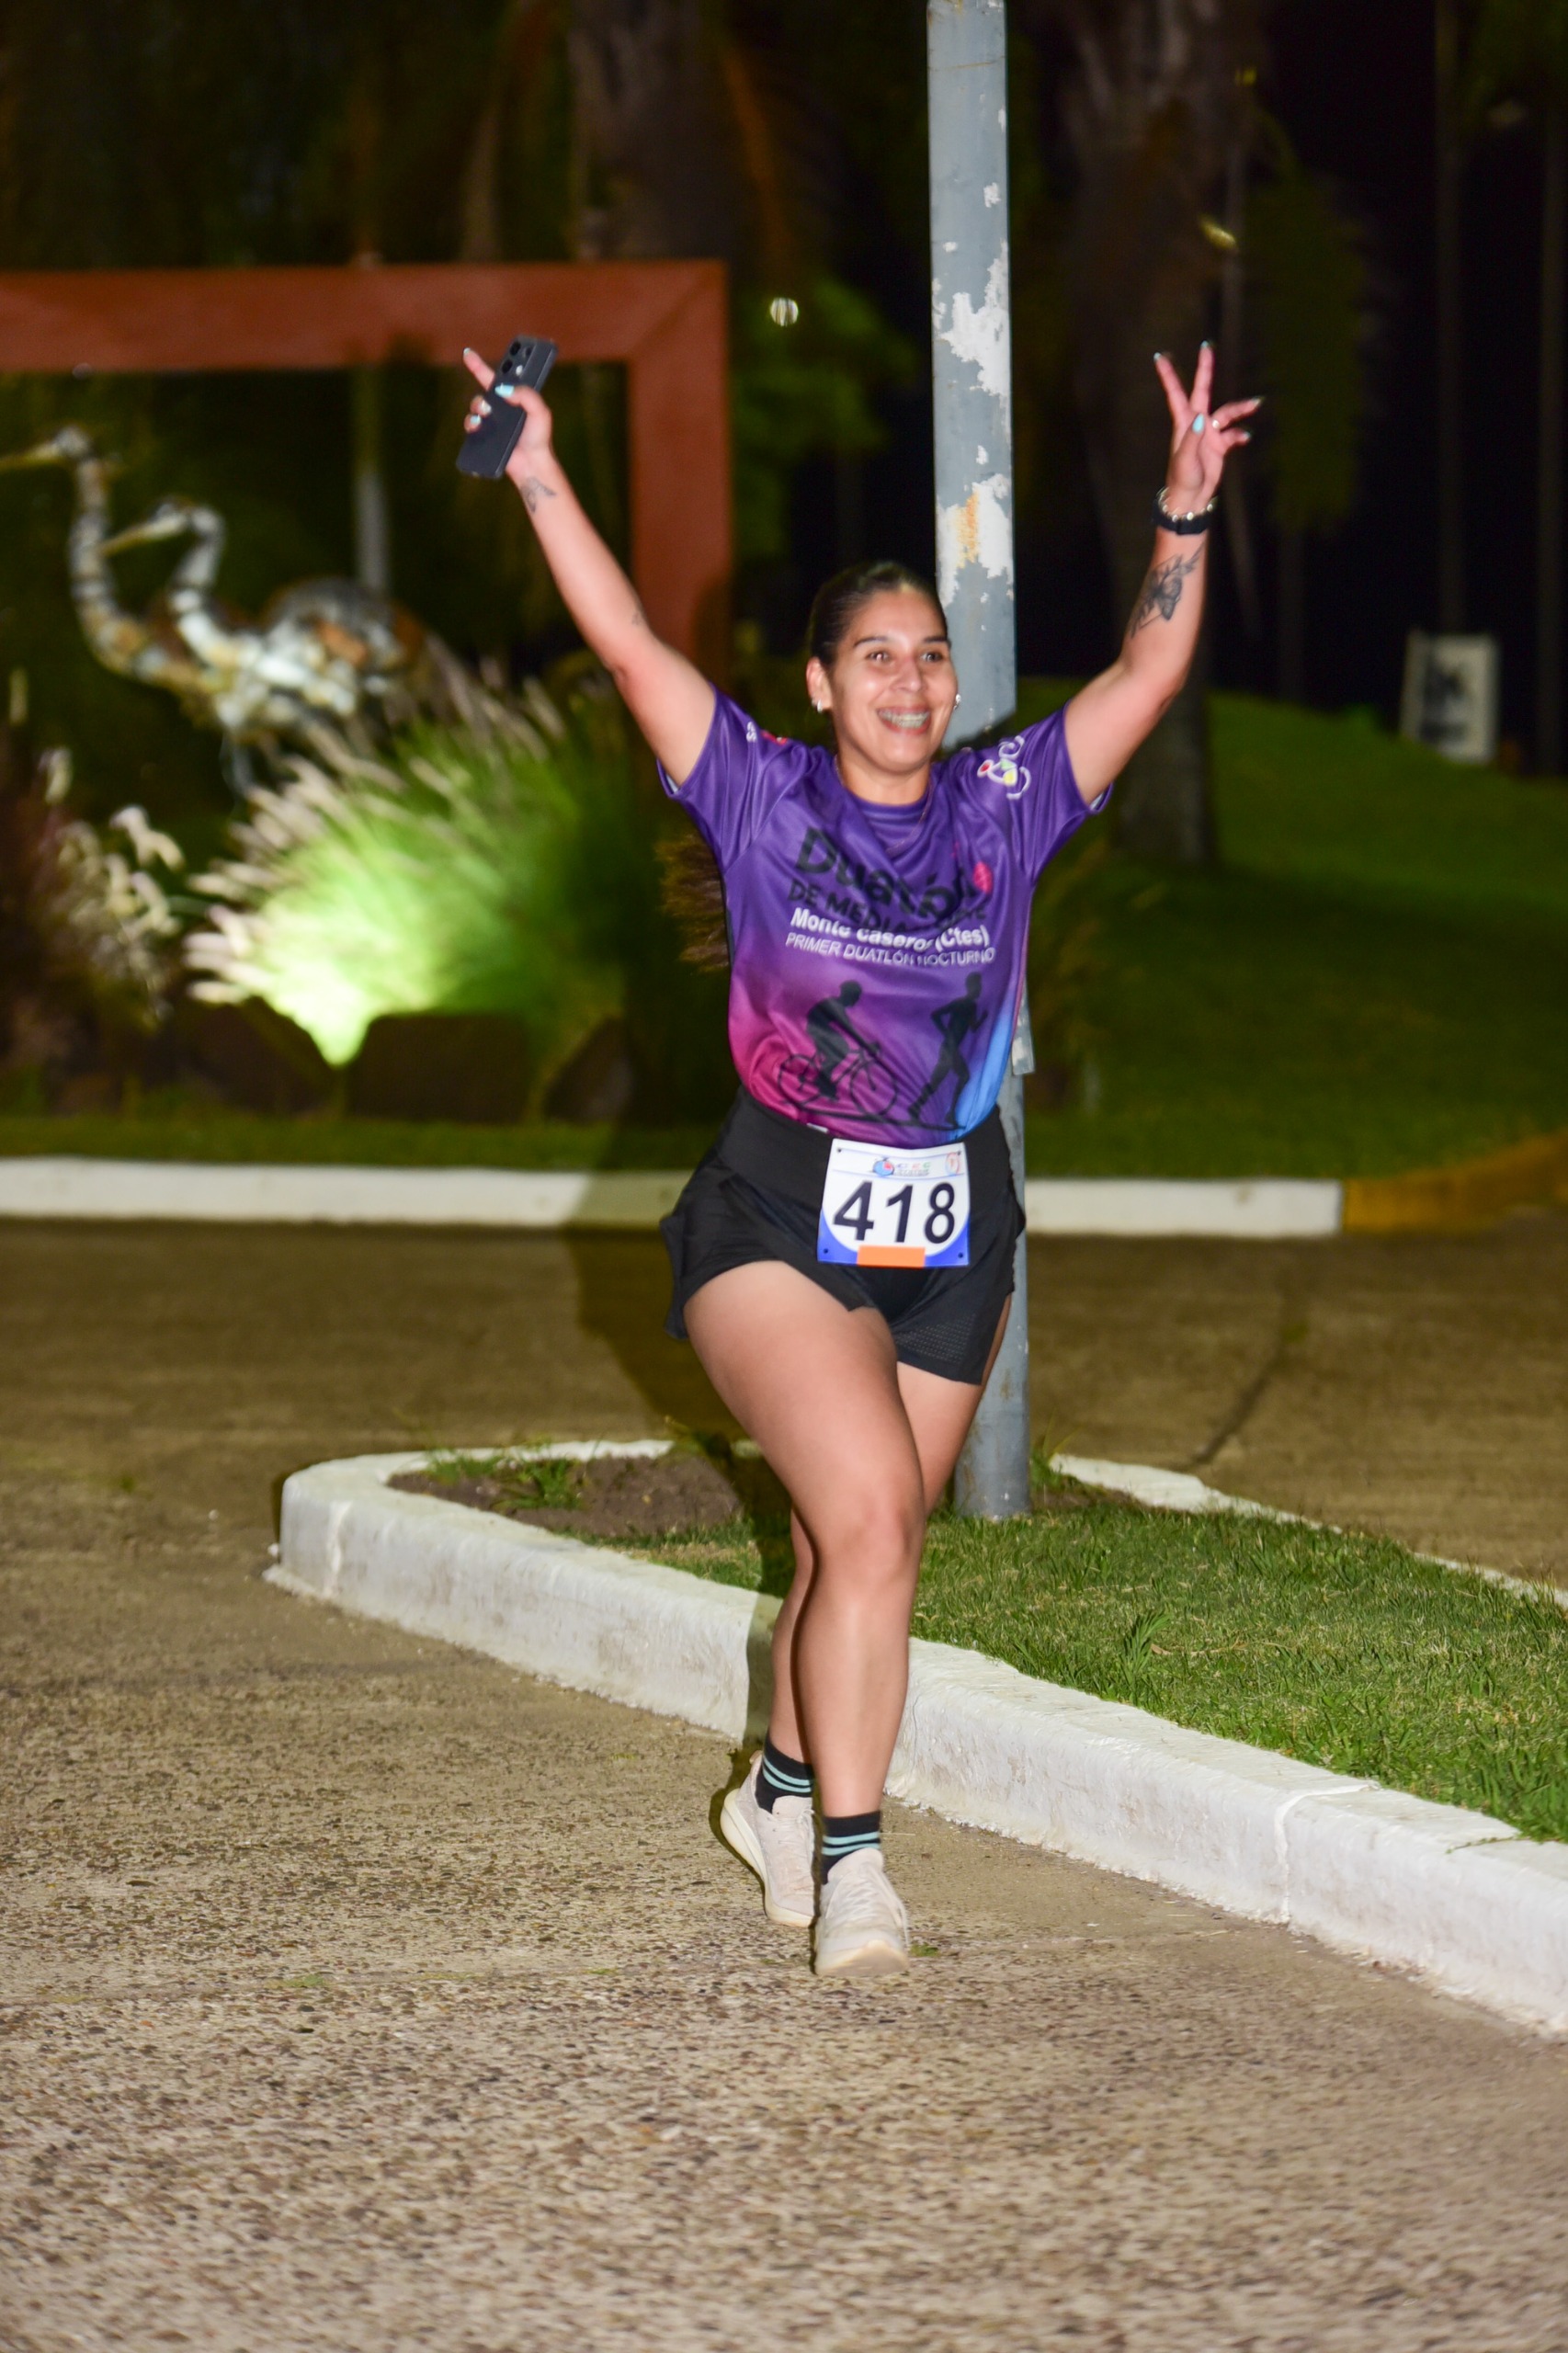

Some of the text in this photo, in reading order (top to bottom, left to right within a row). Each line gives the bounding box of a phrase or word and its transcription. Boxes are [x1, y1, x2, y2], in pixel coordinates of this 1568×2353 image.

[788, 878, 822, 907] DE
[786, 932, 995, 967] PRIMER DUATLÓN NOCTURNO
[790, 907, 851, 938] Monte
[935, 925, 990, 952] (Ctes)
[833, 1180, 955, 1244] 418
